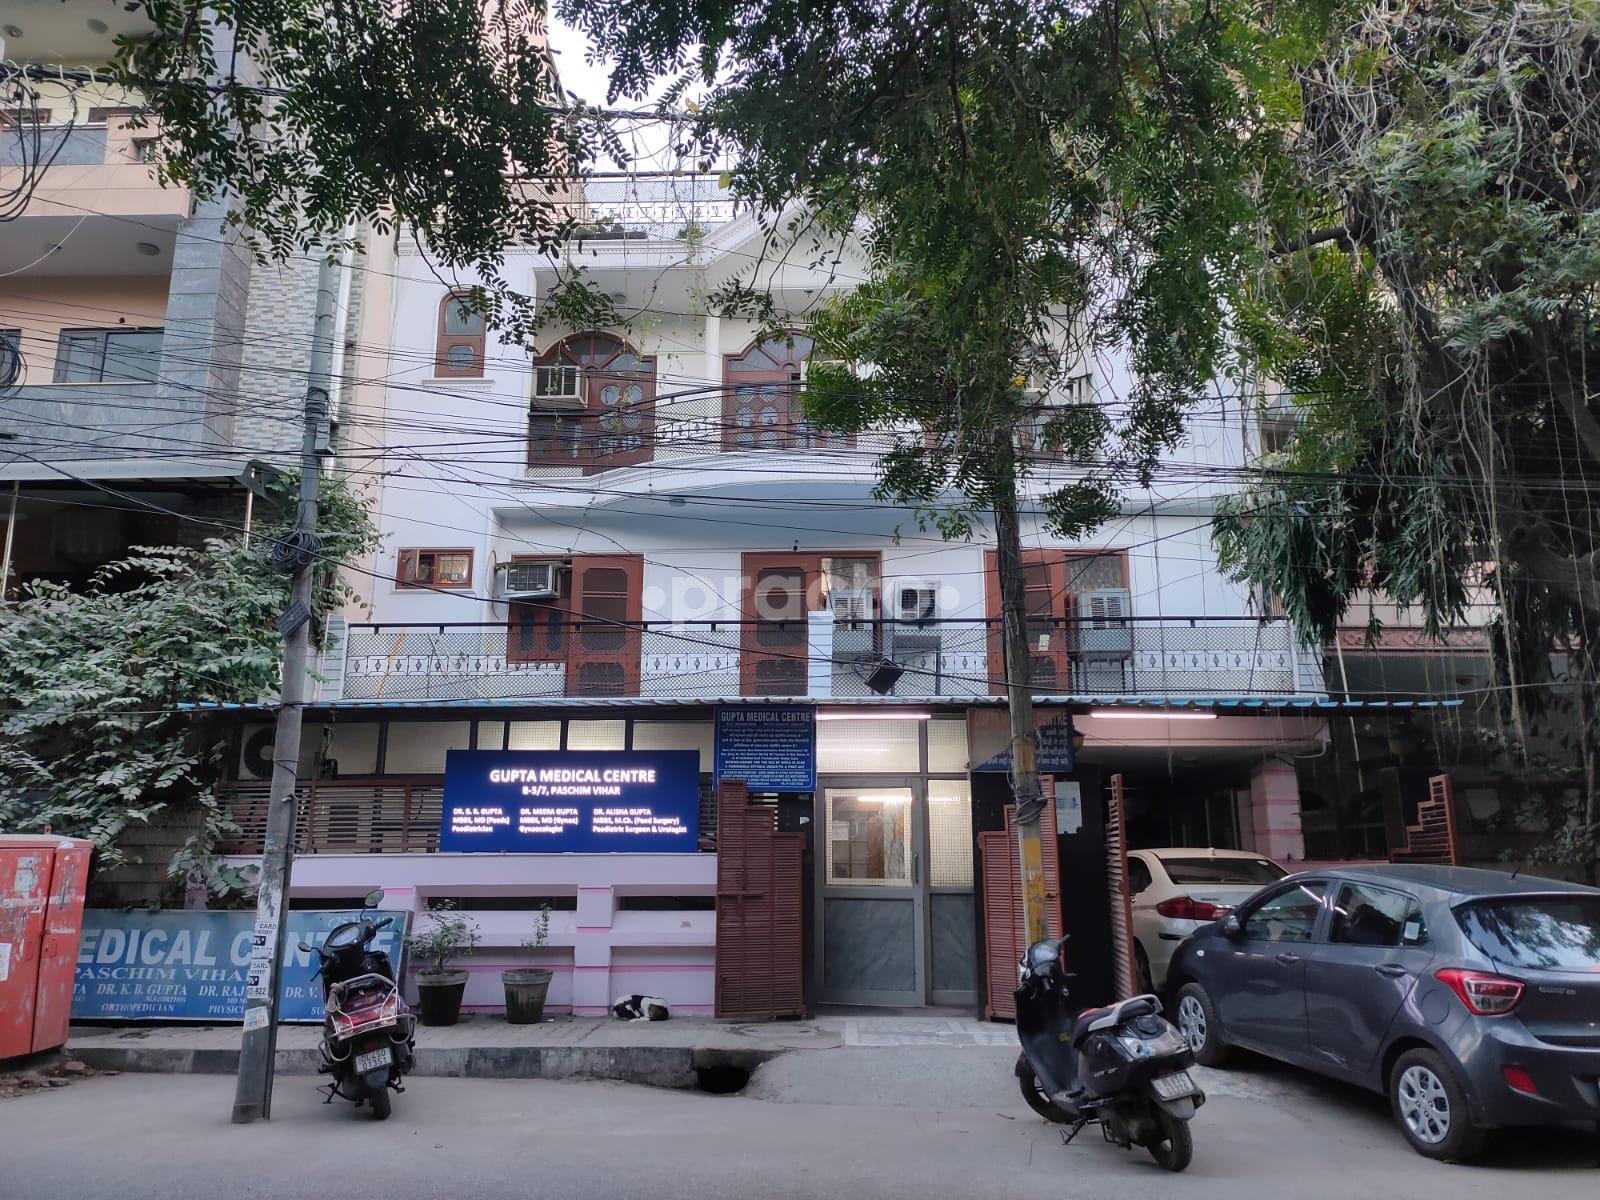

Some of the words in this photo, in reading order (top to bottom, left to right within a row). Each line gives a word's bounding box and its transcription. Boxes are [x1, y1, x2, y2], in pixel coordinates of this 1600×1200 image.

[721, 711, 745, 722] GUPTA
[746, 711, 779, 722] MEDICAL
[781, 711, 811, 722] CENTRE
[490, 768, 538, 783] GUPTA
[540, 768, 601, 783] MEDICAL
[603, 768, 656, 783] CENTRE
[522, 786, 550, 797] B-5/7,
[551, 786, 591, 796] PASCHIM
[593, 786, 621, 796] VIHAR
[77, 929, 217, 966] EDICAL
[185, 969, 250, 982] VIHA
[96, 983, 117, 995] DR.
[120, 983, 132, 995] K.
[134, 984, 144, 995] B.
[147, 984, 187, 996] GUPTA
[199, 985, 218, 997] DR.
[222, 985, 248, 997] RAJ
[284, 986, 304, 998] DR.
[101, 1003, 175, 1012] ORTHOPEDICIAN
[207, 1005, 245, 1014] PHYSICI
